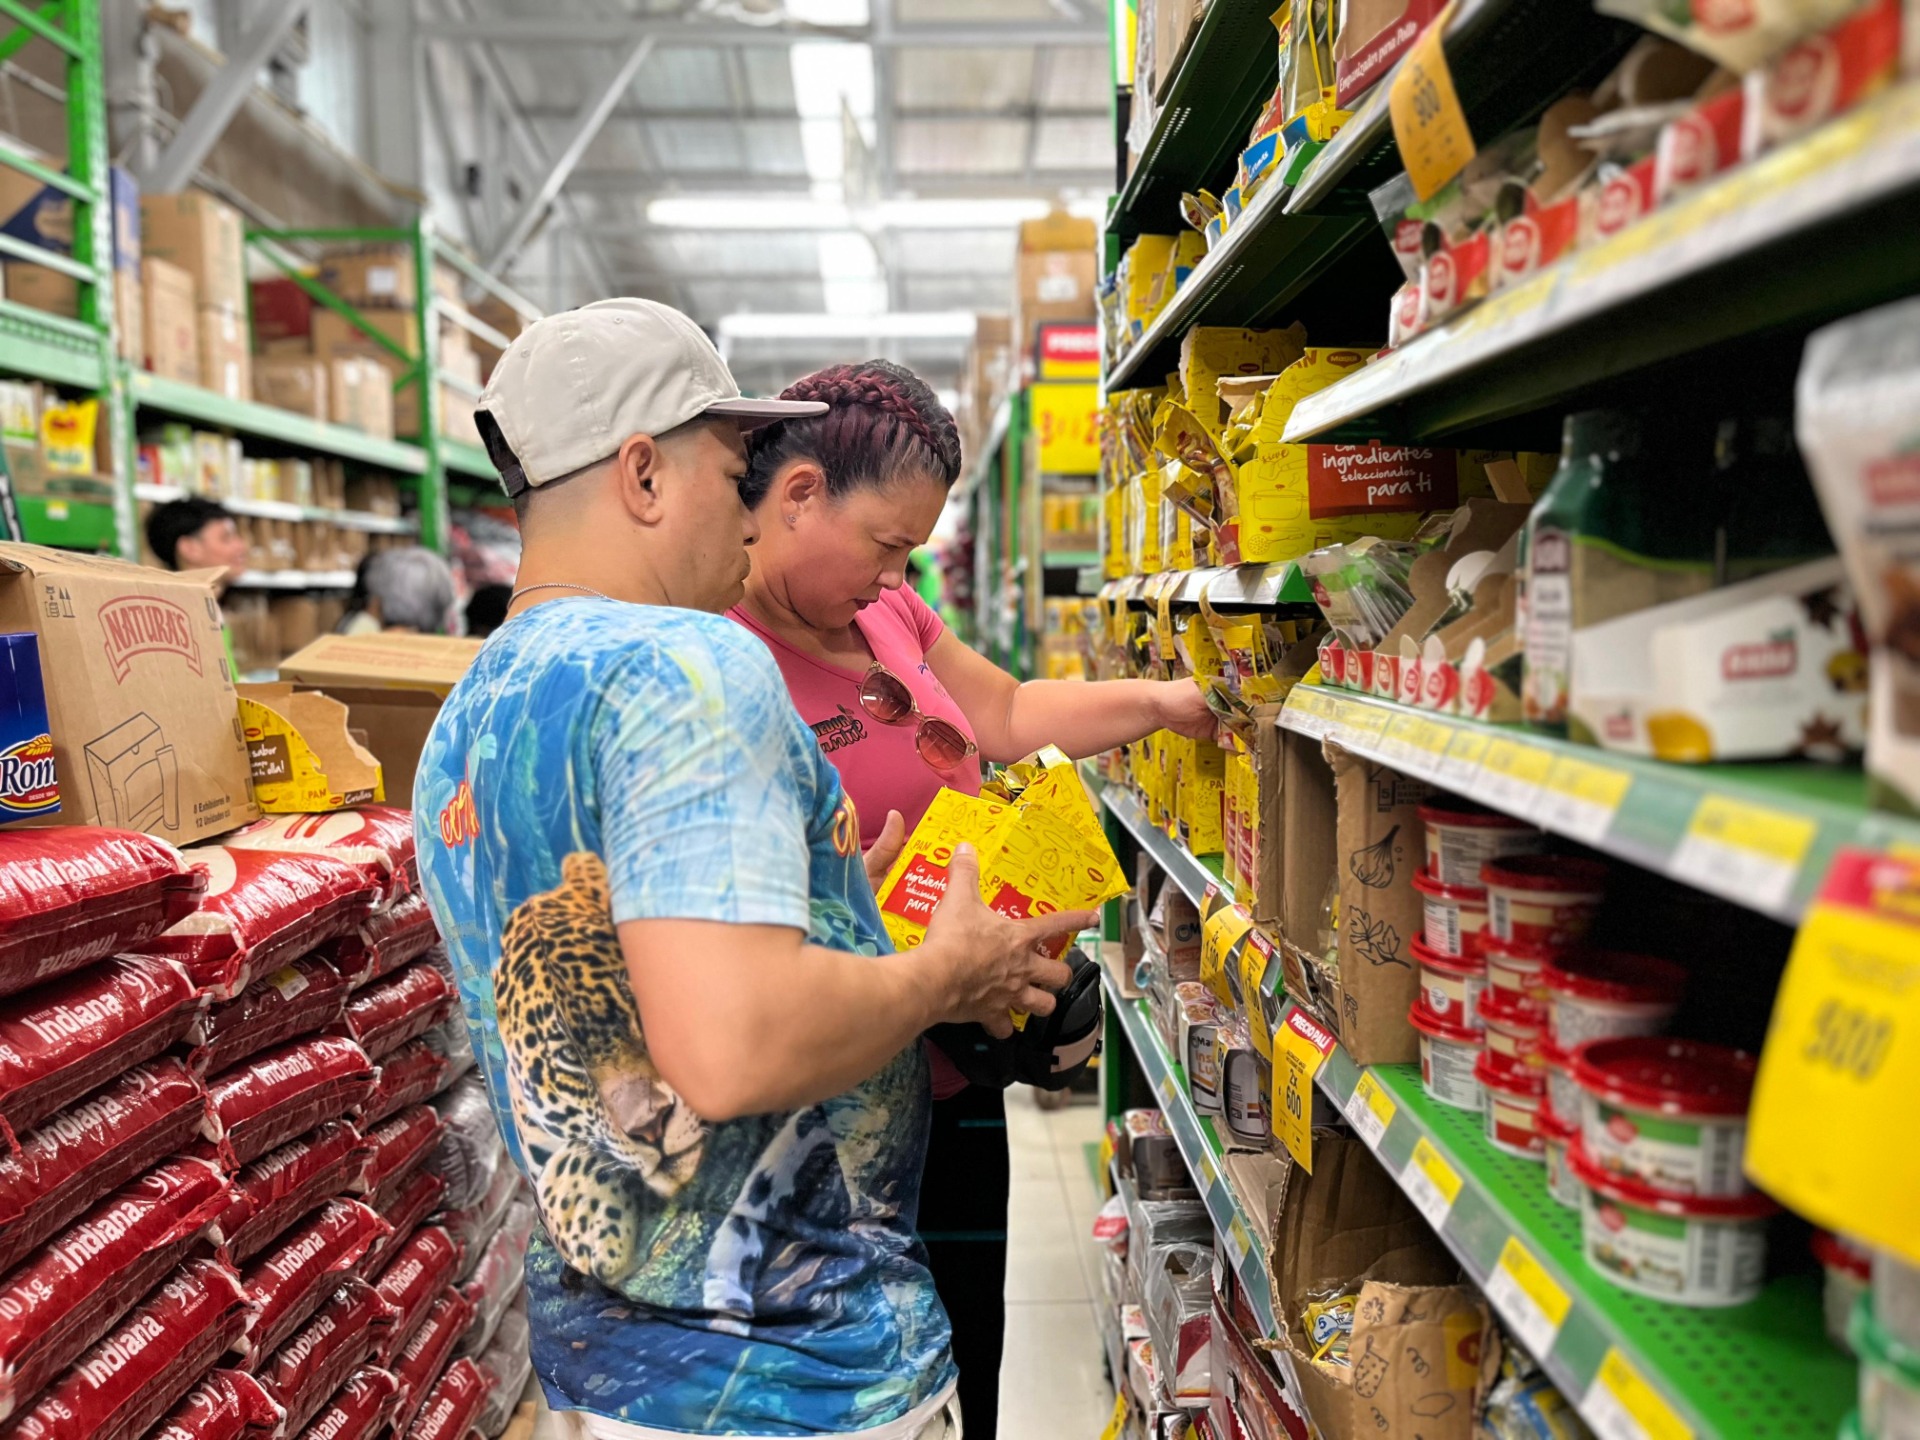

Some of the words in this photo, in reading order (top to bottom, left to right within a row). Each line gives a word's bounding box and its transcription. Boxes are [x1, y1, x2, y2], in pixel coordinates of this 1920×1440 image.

[1322, 447, 1433, 475] ingredientes
[1340, 466, 1416, 482] seleccionados
[1367, 480, 1413, 505] para
[1416, 472, 1432, 493] ti
[104, 605, 190, 652] NATURA'S
[904, 869, 947, 892] ingrediente
[903, 897, 930, 913] para
[20, 992, 124, 1044] Indiana
[1290, 1013, 1315, 1038] PRECIO
[1311, 1030, 1333, 1050] PALÍ
[1290, 1068, 1298, 1089] 2x
[1286, 1085, 1302, 1120] 600
[32, 1094, 124, 1153] Indiana
[48, 1200, 145, 1274] Indiana
[264, 1231, 327, 1281] Indiana
[72, 1314, 165, 1390] Indiana
[278, 1314, 337, 1369] Indiana
